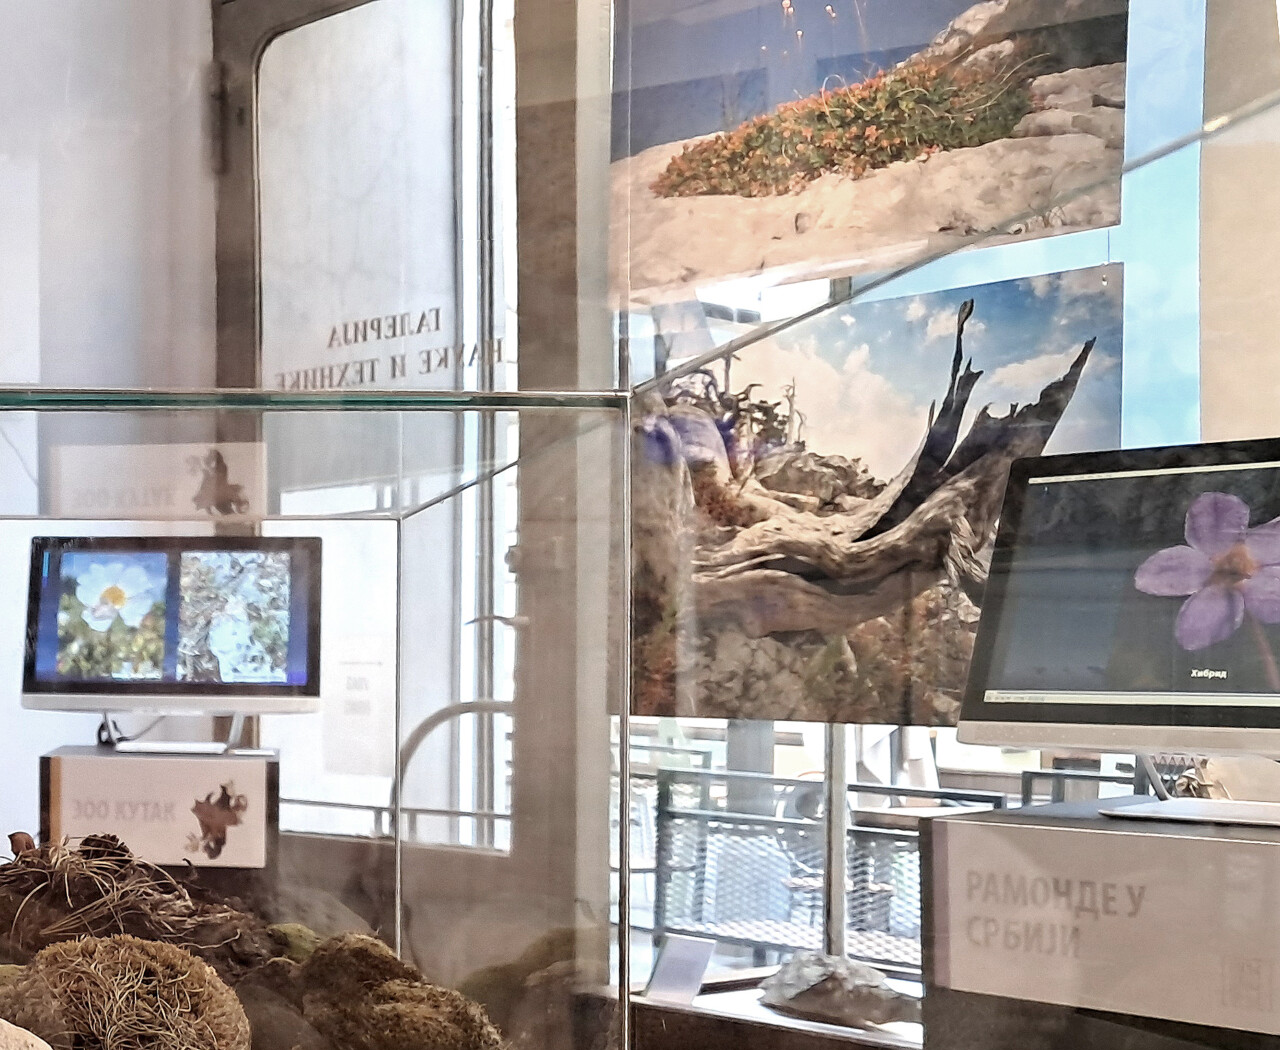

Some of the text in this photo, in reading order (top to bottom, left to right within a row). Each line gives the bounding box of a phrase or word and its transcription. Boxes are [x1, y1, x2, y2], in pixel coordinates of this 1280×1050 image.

[1190, 668, 1228, 680] Хибрид
[1125, 884, 1146, 918] У
[967, 915, 1080, 958] СРБИЈИ
